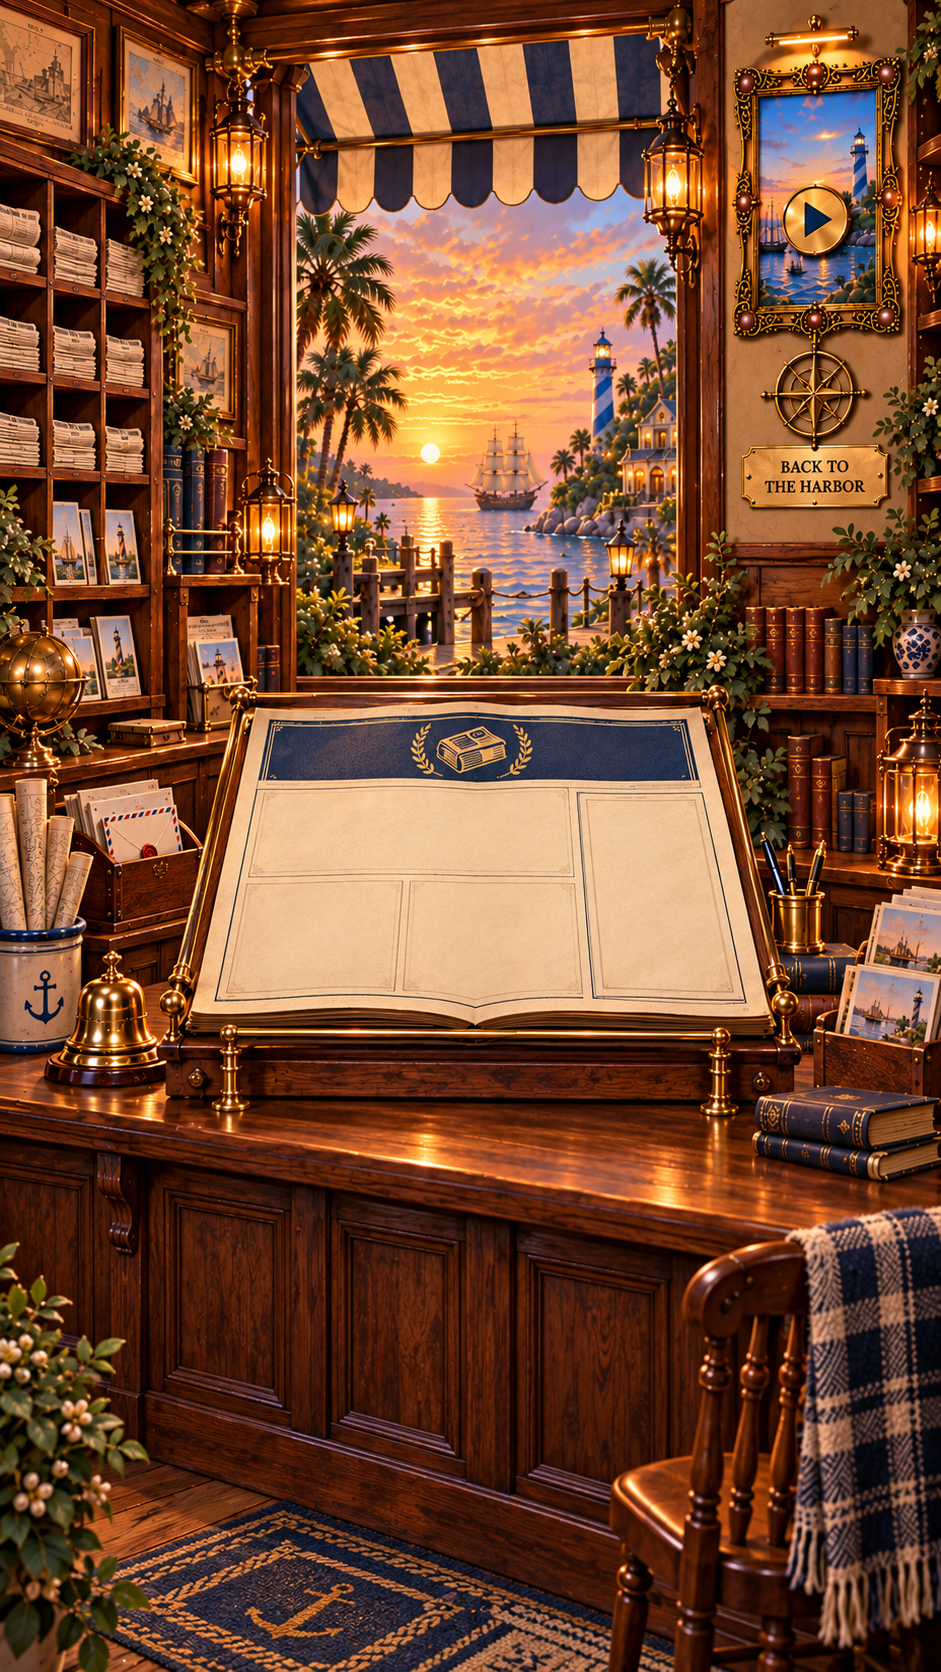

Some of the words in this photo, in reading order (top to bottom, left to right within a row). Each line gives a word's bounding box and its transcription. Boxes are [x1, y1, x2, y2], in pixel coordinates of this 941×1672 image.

[781, 460, 823, 473] BACK
[827, 460, 849, 473] TO
[765, 480, 796, 493] THE
[800, 480, 866, 493] HARBOR
